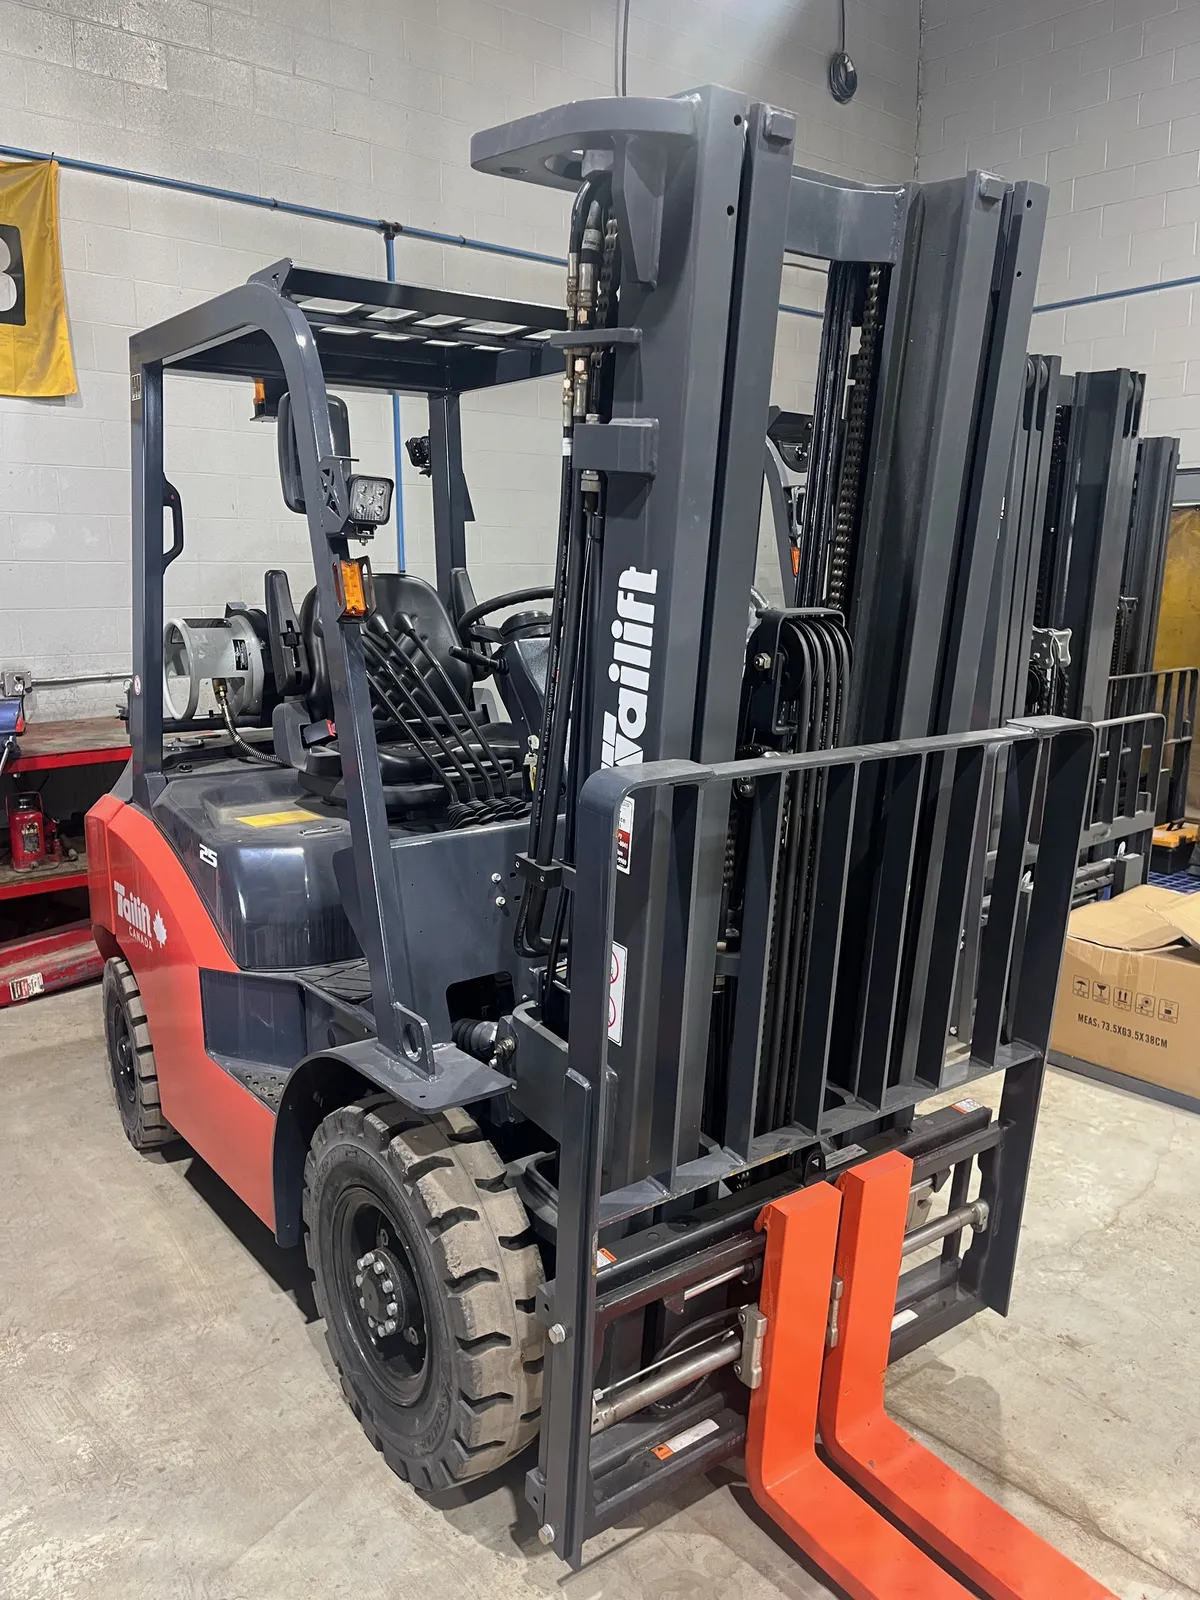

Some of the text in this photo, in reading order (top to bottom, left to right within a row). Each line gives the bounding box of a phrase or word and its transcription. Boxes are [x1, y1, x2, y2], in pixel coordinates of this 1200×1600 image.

[199, 843, 218, 868] 25
[113, 880, 152, 938] Tailift
[128, 926, 153, 951] CANADA
[1101, 1020, 1168, 1048] 73.5X63.5X38CM
